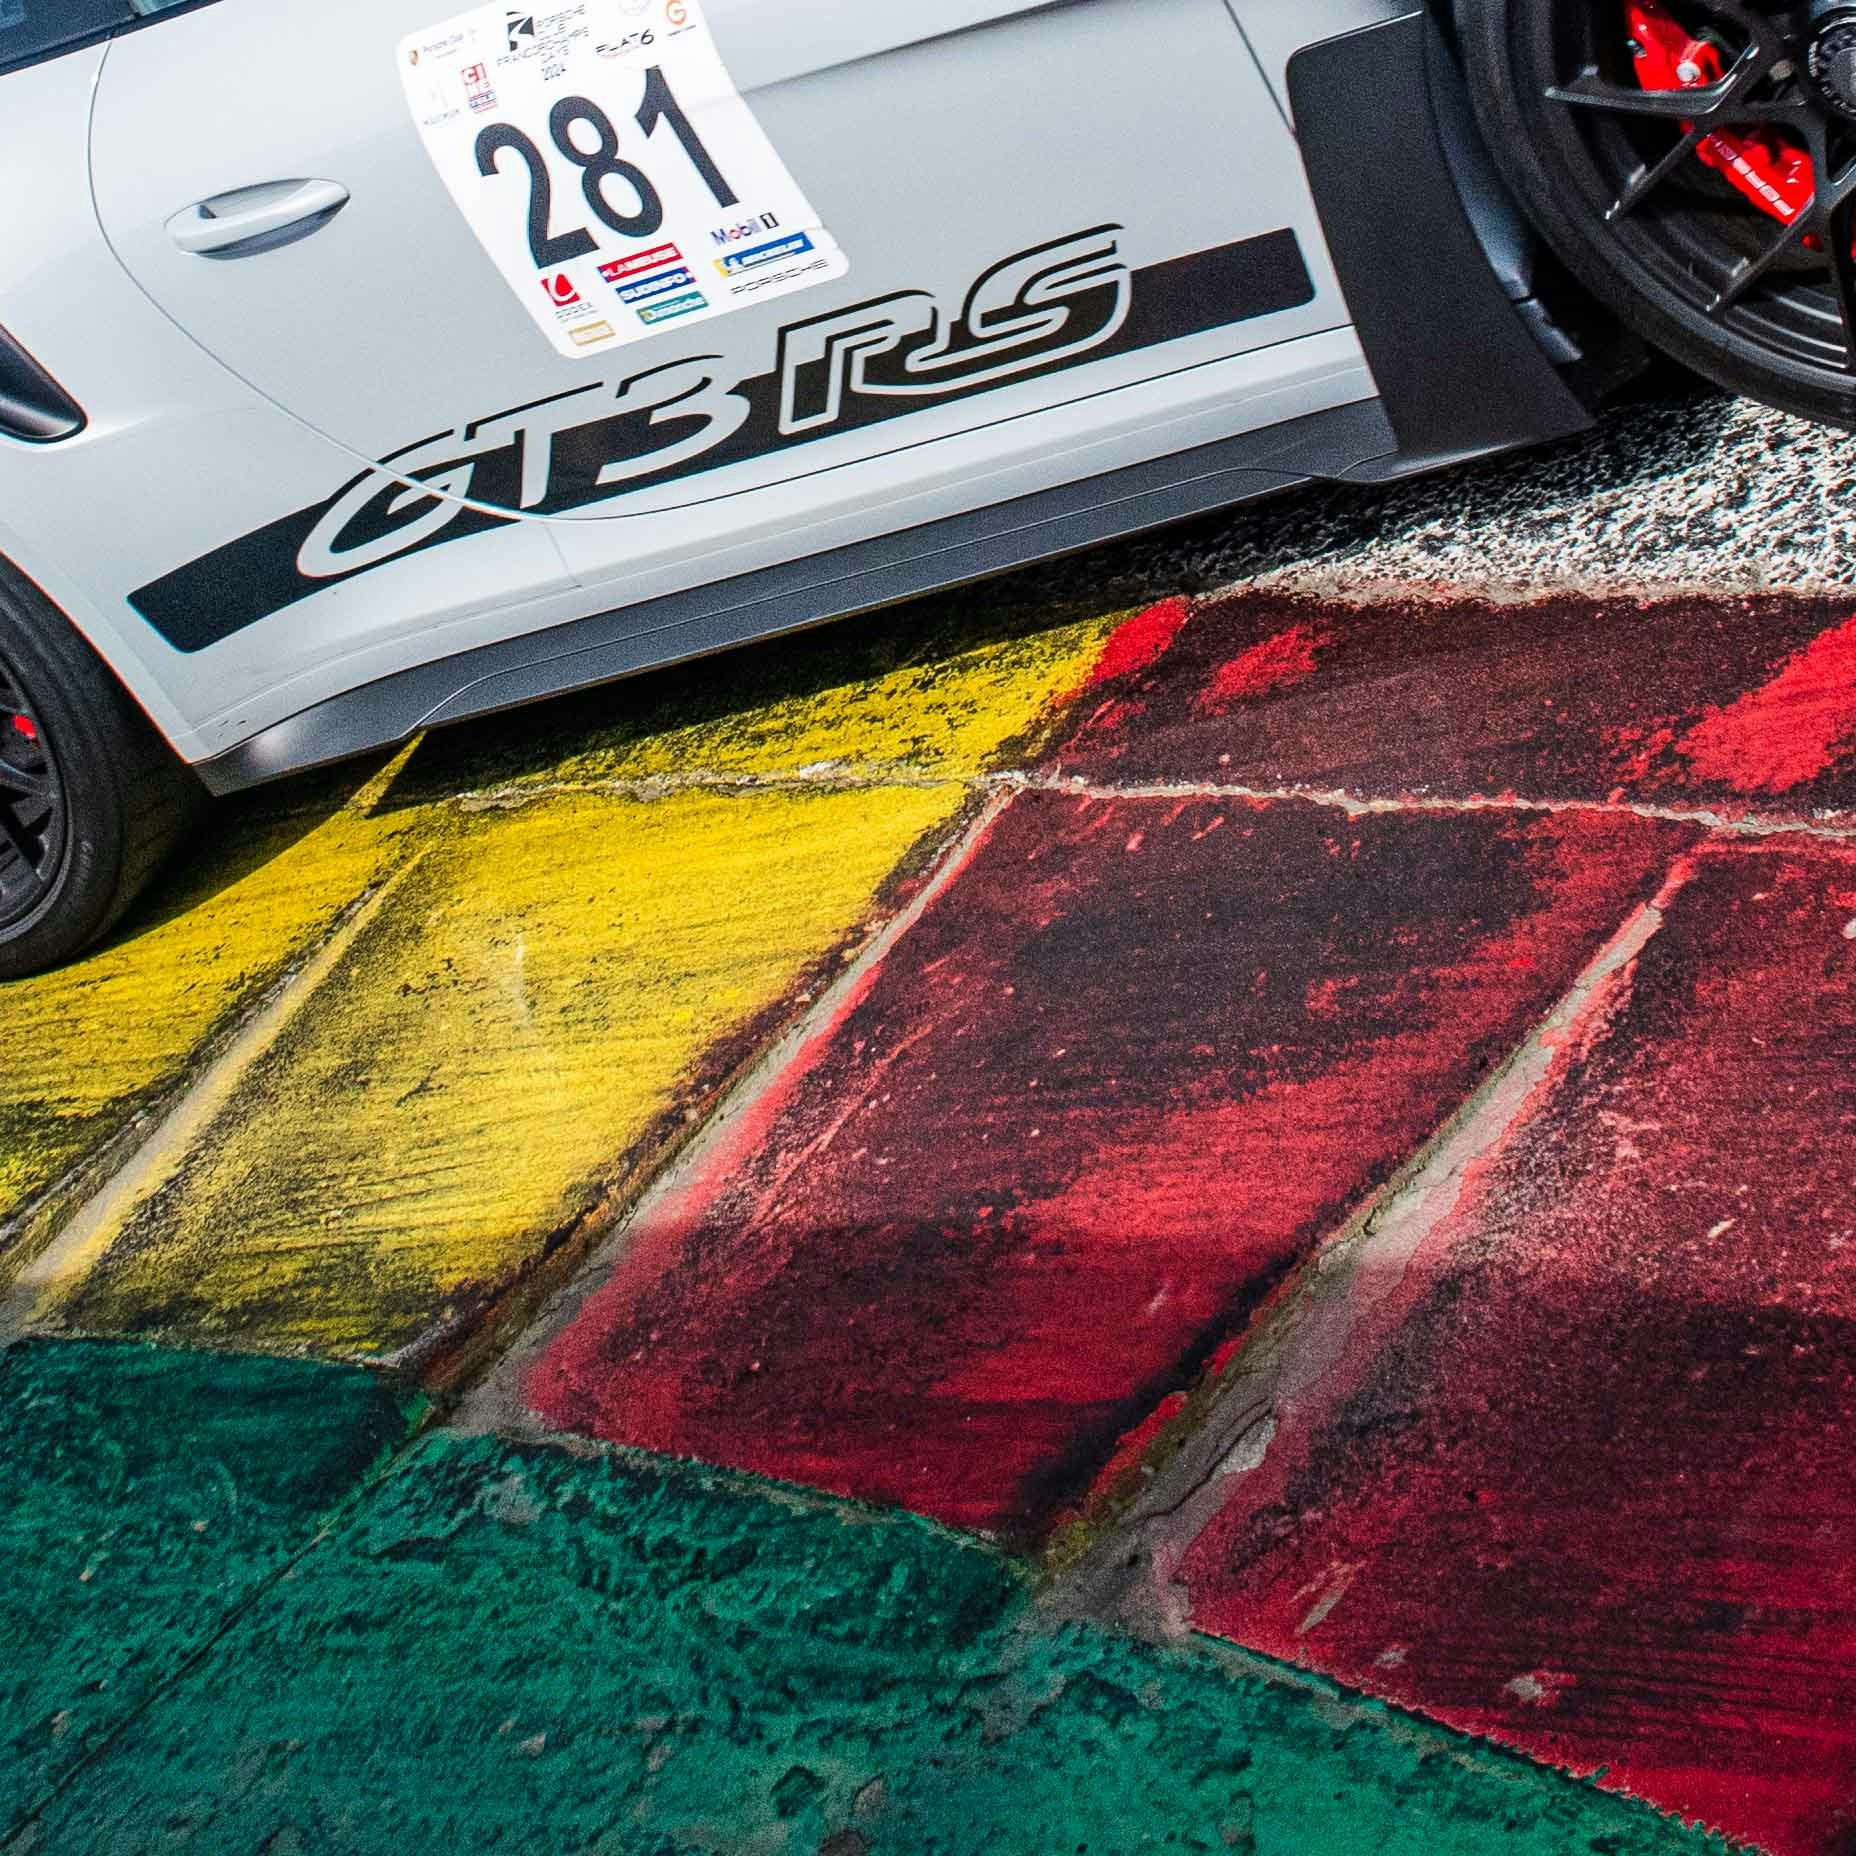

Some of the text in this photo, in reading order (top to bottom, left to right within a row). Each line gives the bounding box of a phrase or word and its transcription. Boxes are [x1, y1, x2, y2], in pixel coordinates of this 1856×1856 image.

[474, 65, 740, 269] 281
[710, 217, 761, 246] Mobil
[730, 259, 828, 294] PORSCHE
[297, 223, 1132, 579] GT3 RS
